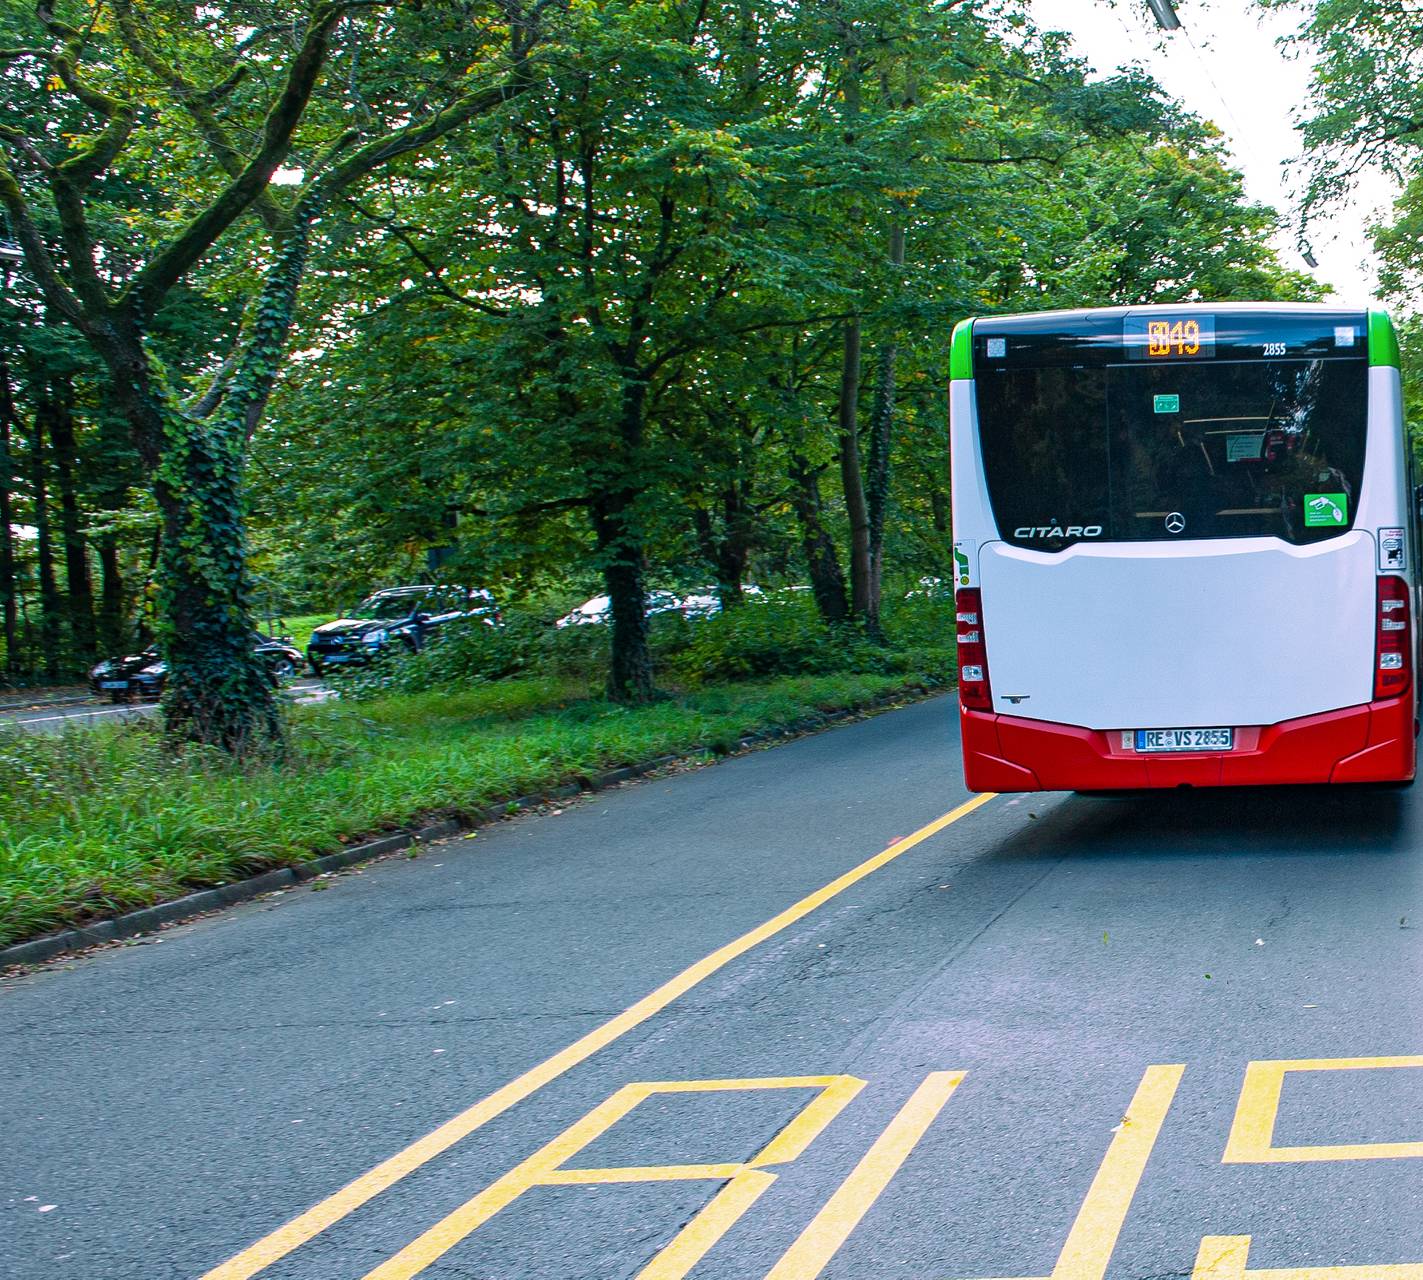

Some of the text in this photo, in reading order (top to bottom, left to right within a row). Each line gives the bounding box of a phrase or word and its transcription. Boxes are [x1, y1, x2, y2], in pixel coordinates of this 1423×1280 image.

[1263, 342, 1286, 356] 2855
[1014, 525, 1103, 538] CITARO
[1147, 729, 1229, 747] RE VS 2855
